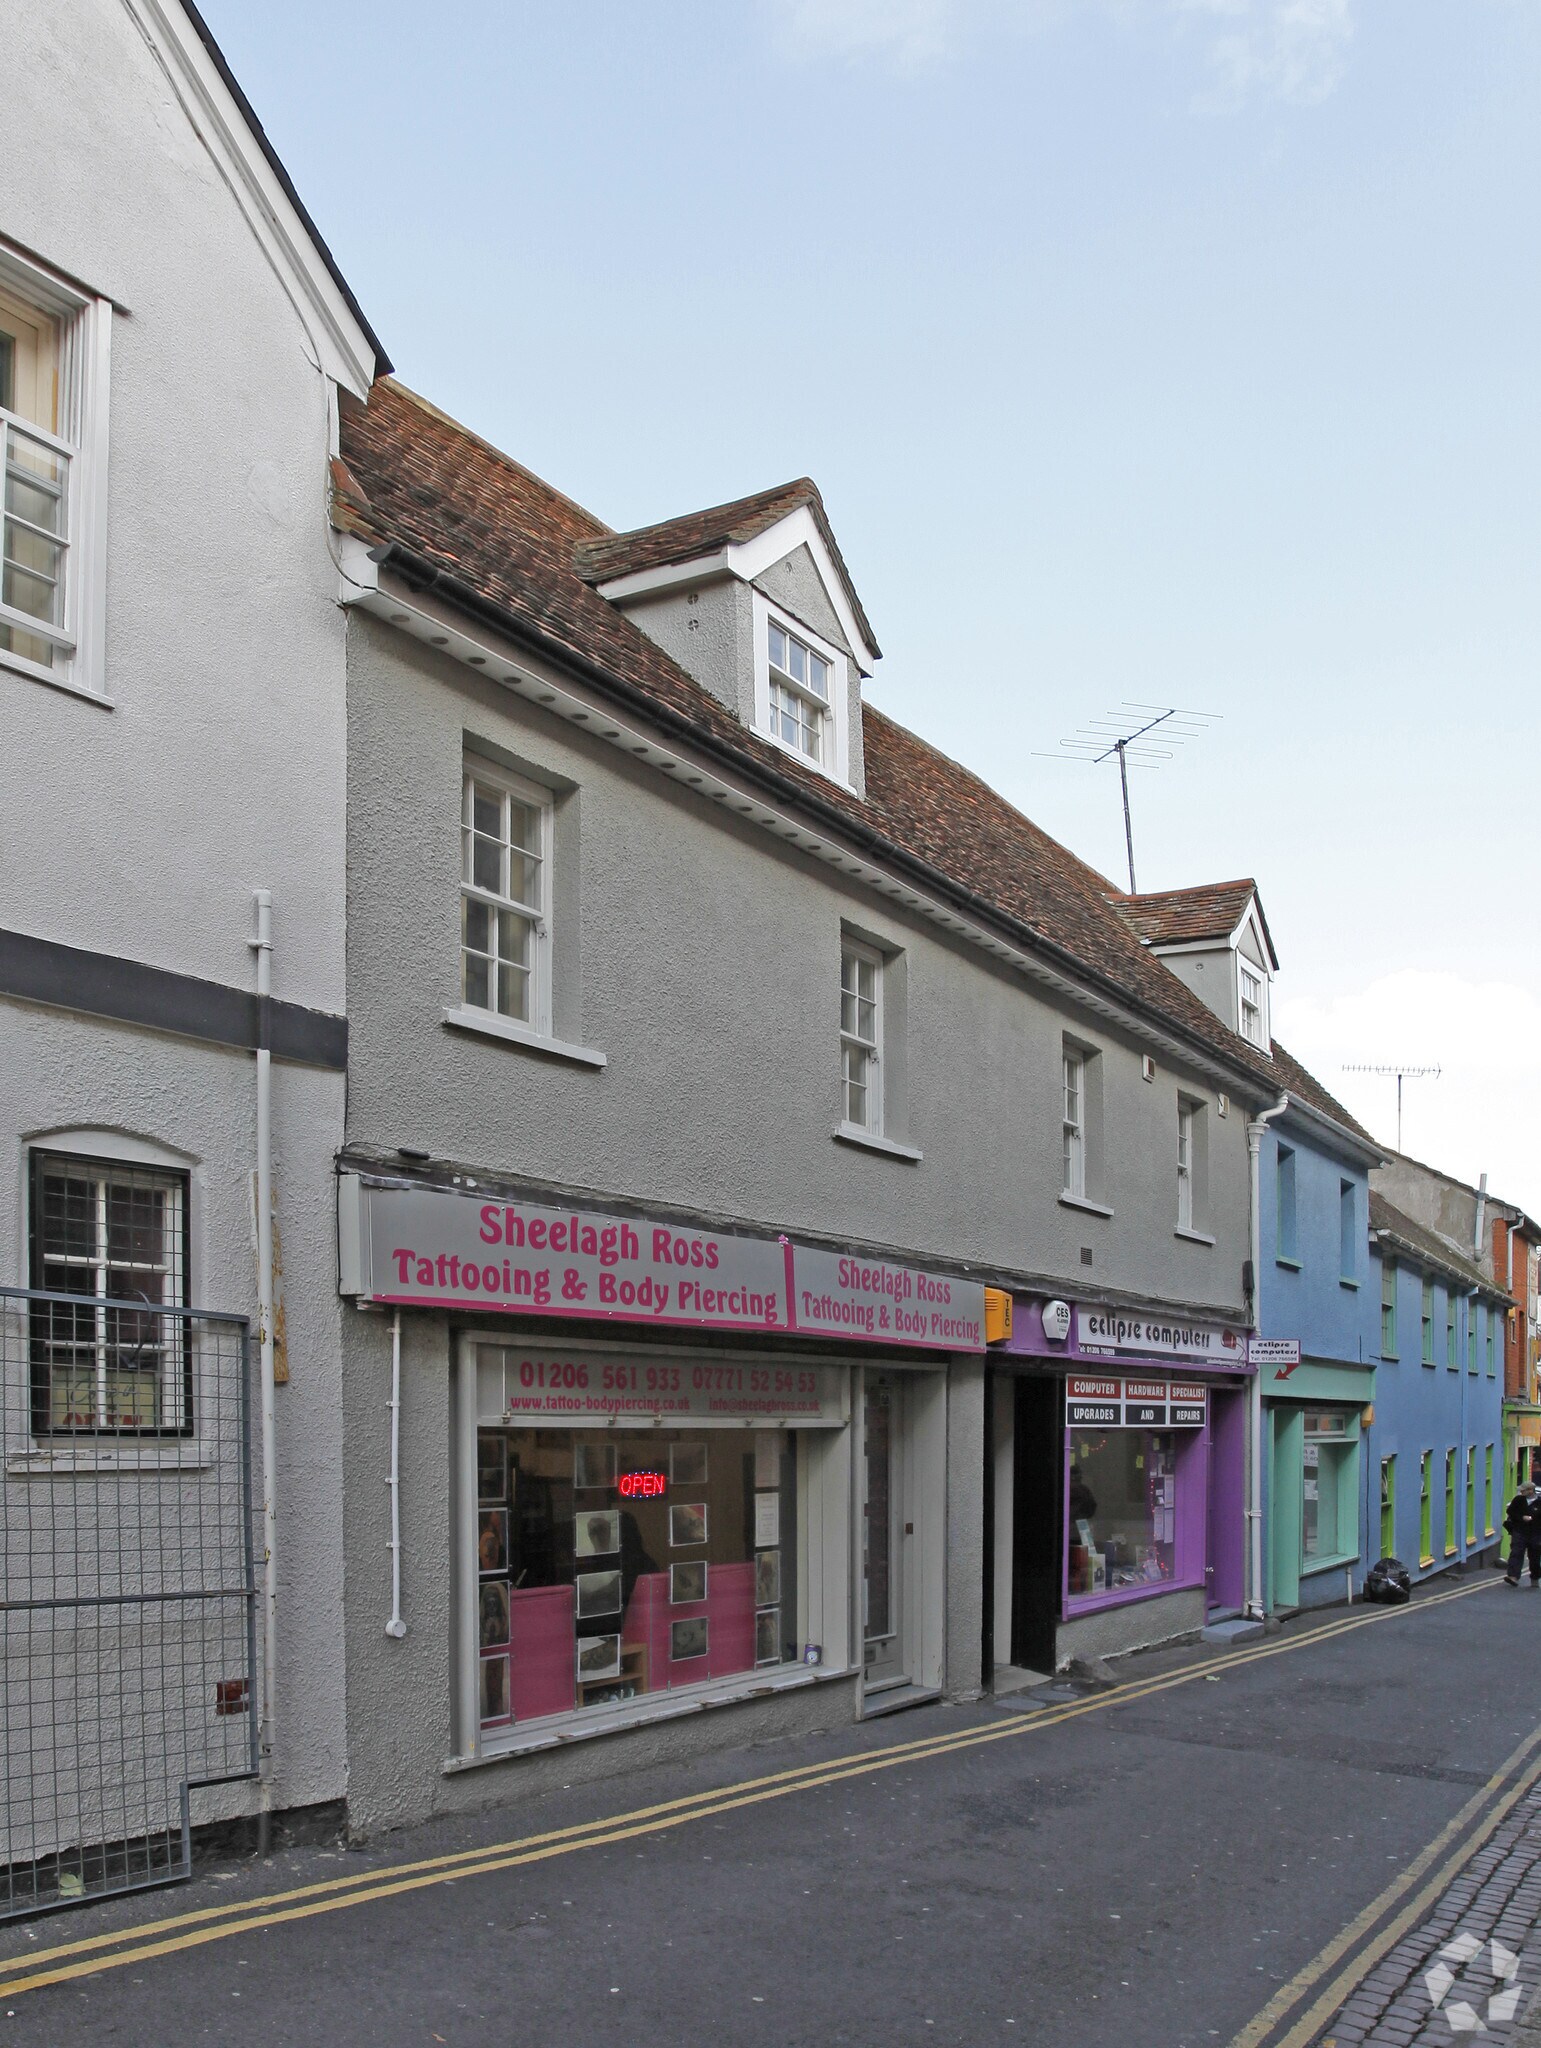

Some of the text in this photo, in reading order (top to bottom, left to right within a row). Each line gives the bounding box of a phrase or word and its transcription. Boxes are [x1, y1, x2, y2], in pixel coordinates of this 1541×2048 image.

[480, 1205, 720, 1270] Sheelagh Ross
[392, 1248, 778, 1325] Tattooing & Body Piercing
[838, 1258, 951, 1304] Sheelagh Ross
[802, 1291, 980, 1345] Tattooing & Body Piercing
[1056, 1307, 1069, 1318] CES
[1089, 1311, 1210, 1349] eclipse computers
[1257, 1341, 1290, 1349] eclipse
[519, 1361, 589, 1389] 01206
[602, 1365, 637, 1390] 561
[646, 1367, 681, 1391] 933
[692, 1366, 743, 1391] 07771
[751, 1370, 770, 1392] 52
[774, 1371, 794, 1392] 54
[1074, 1381, 1115, 1394] COMPUTER
[1128, 1385, 1164, 1396] HARDWARE
[1172, 1387, 1204, 1397] SPECIALIST
[510, 1396, 690, 1413] www.tattoo-bodypiercing.co.uk
[1073, 1408, 1114, 1420] UPGRADES
[1140, 1410, 1154, 1420] AND
[1176, 1411, 1200, 1420] REPAIRS
